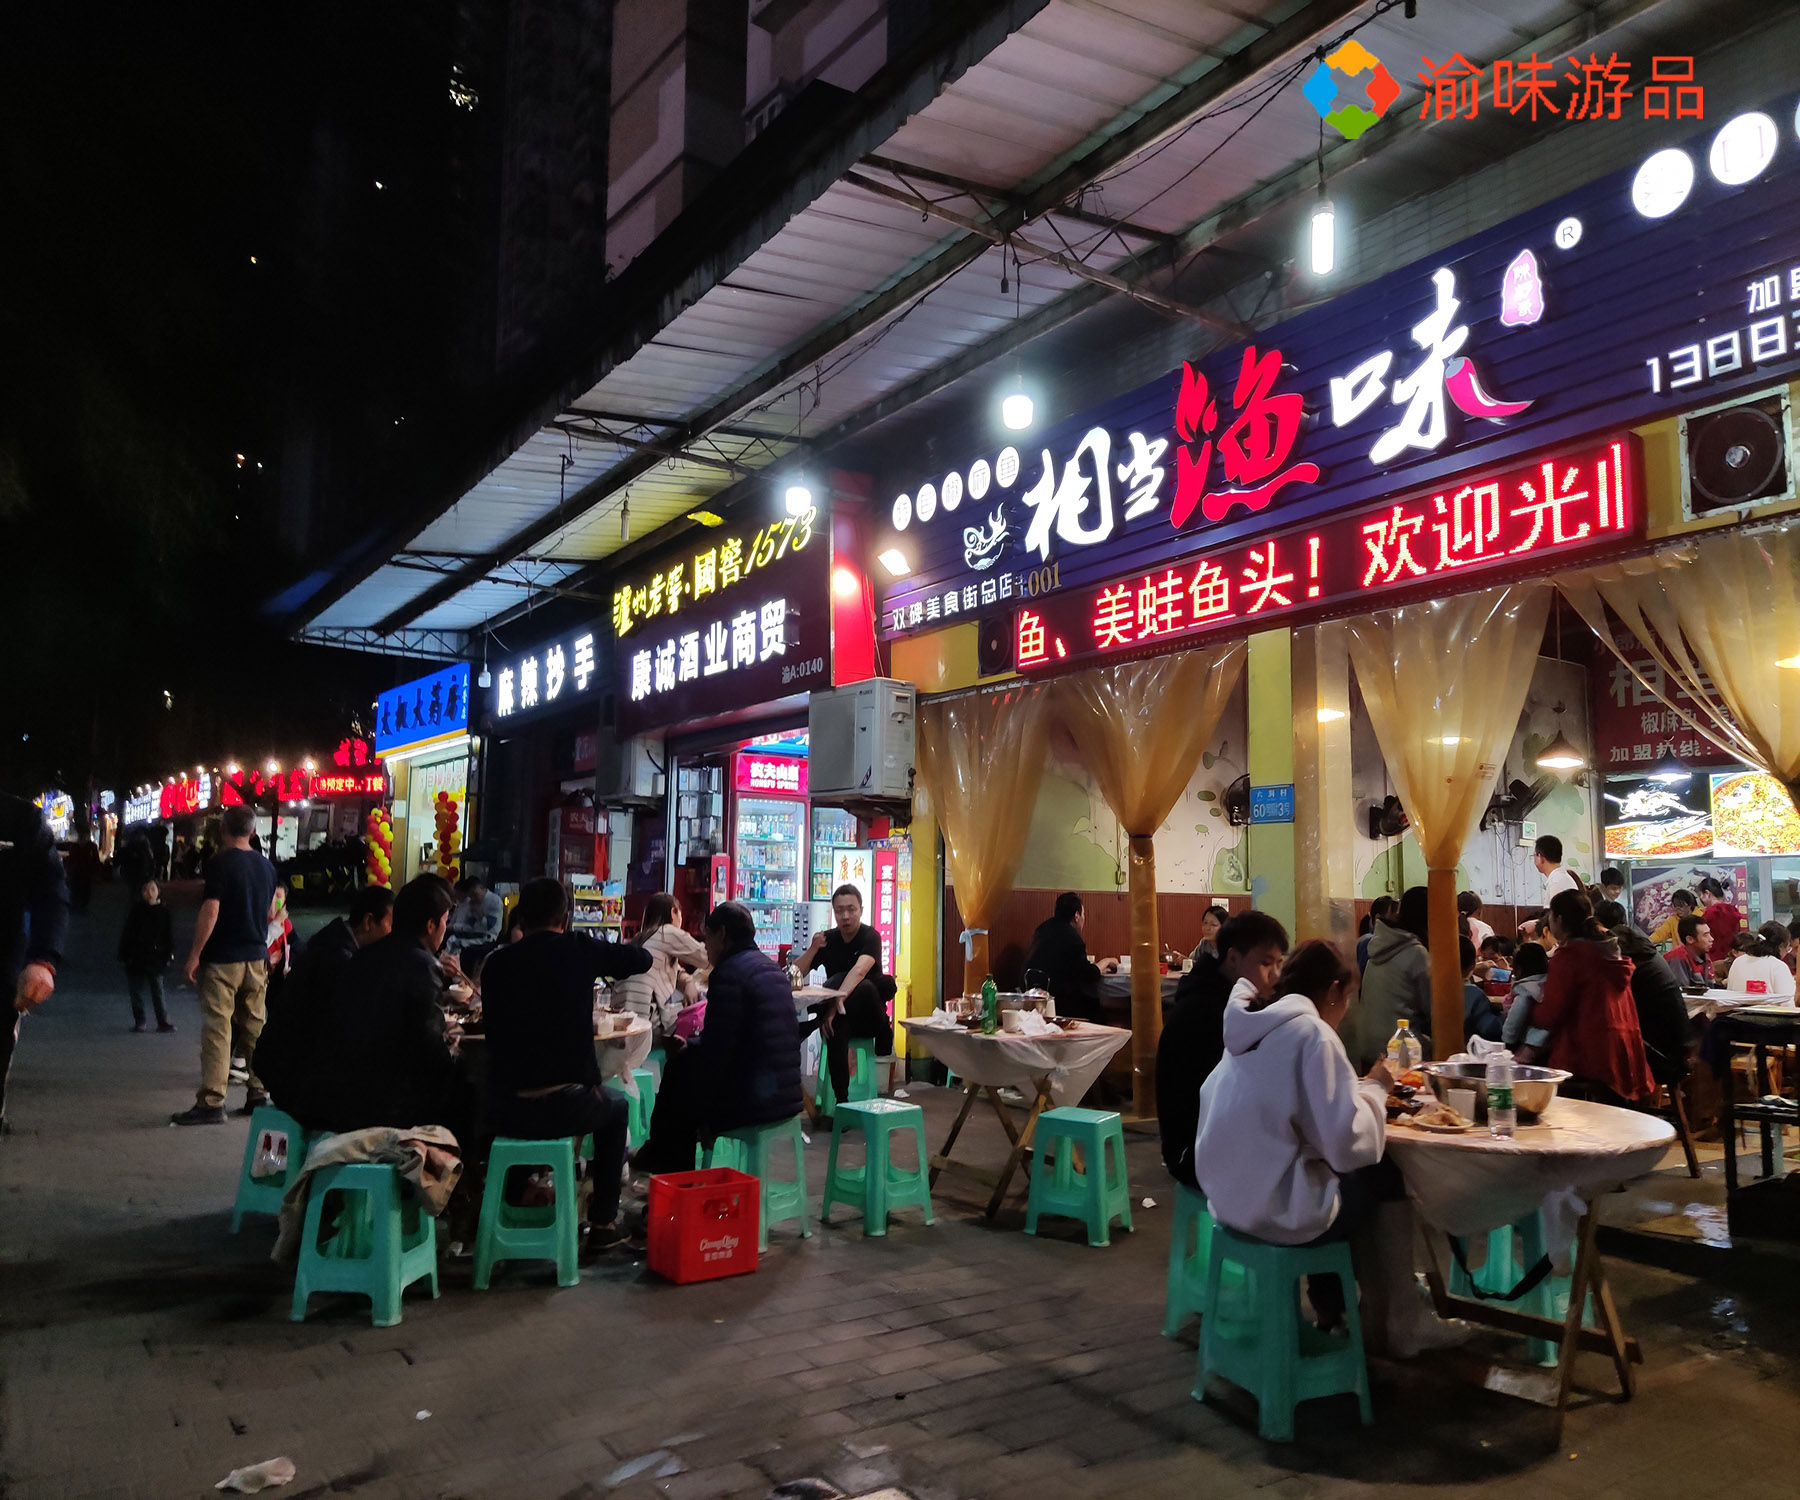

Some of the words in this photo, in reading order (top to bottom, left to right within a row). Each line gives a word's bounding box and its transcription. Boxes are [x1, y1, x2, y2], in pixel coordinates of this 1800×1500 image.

[1646, 309, 1800, 393] 1388
[892, 572, 1013, 632] 双碑美食街总店
[498, 633, 595, 717] 麻辣抄手
[630, 598, 787, 701] 康诚酒业商贸
